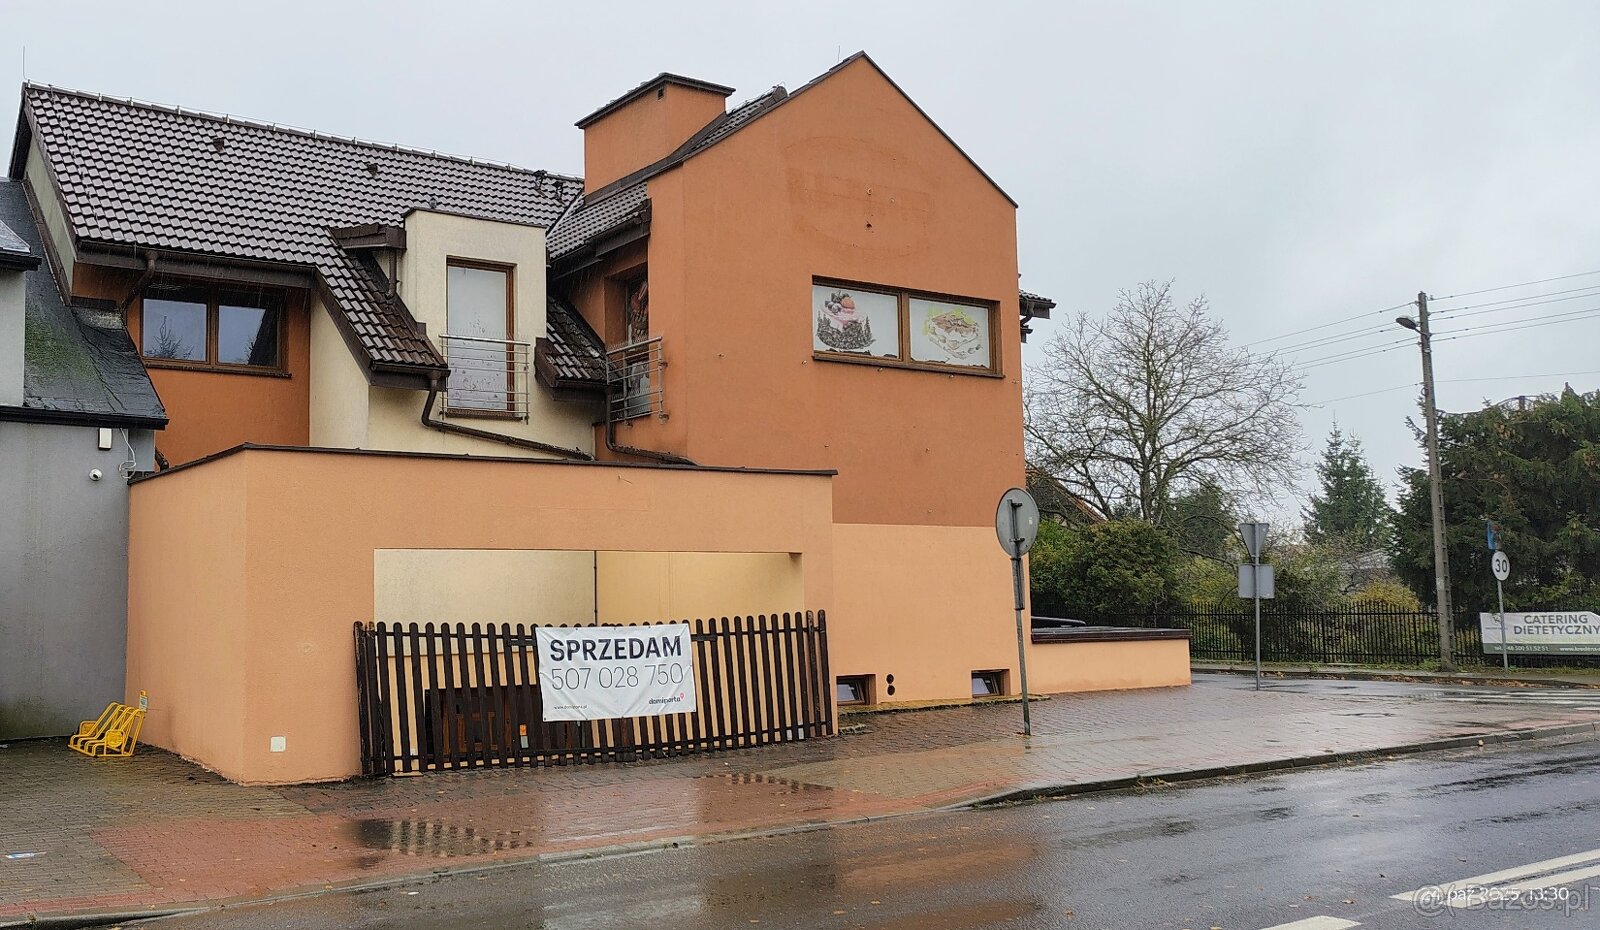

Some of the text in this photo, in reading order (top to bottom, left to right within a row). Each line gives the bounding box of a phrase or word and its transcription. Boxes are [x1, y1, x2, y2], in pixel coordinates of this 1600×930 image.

[1495, 558, 1507, 573] 30
[1523, 614, 1589, 624] CATERING
[1513, 625, 1600, 635] DIETETYCZNY
[550, 635, 682, 661] SPRZEDAM
[551, 662, 684, 691] 507 028 750
